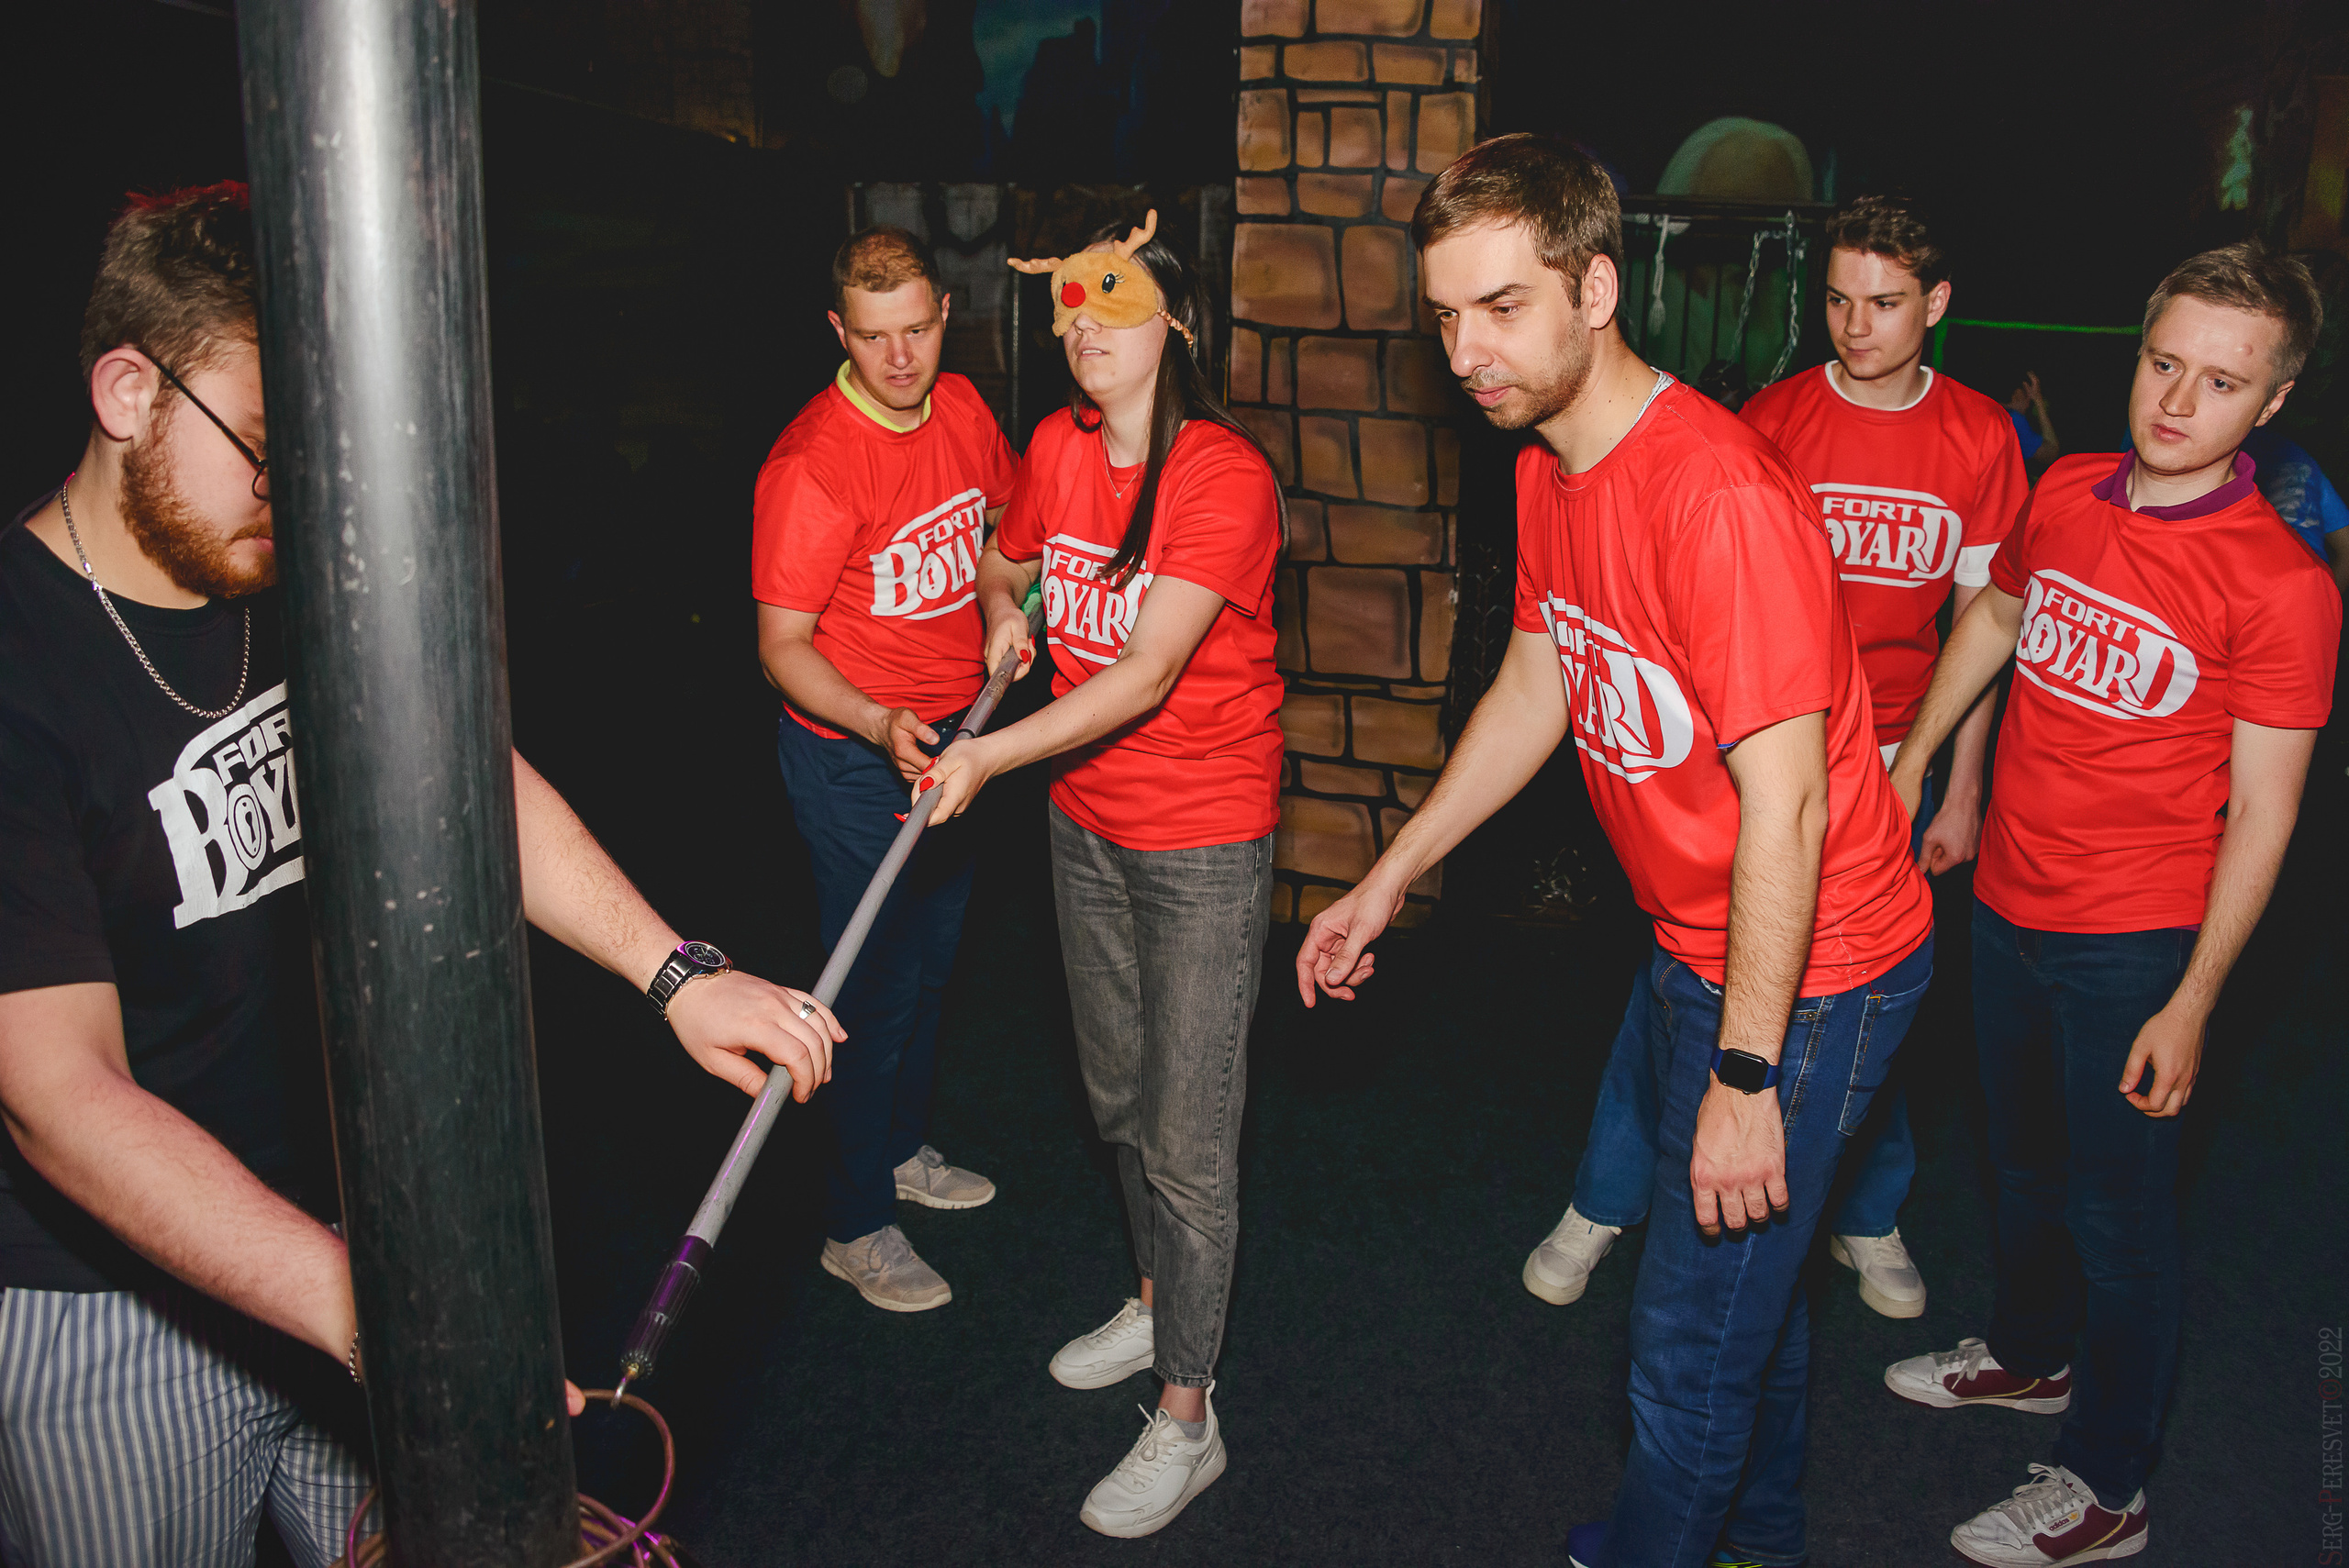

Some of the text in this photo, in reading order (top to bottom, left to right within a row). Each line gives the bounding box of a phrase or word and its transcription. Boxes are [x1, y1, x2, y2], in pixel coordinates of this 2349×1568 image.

[918, 506, 974, 551] FORT
[1822, 496, 1917, 522] FORT
[1823, 506, 1963, 580] OYARD
[2043, 587, 2135, 642] FORT
[213, 708, 293, 785] FOR
[2049, 1518, 2070, 1531] adidas
